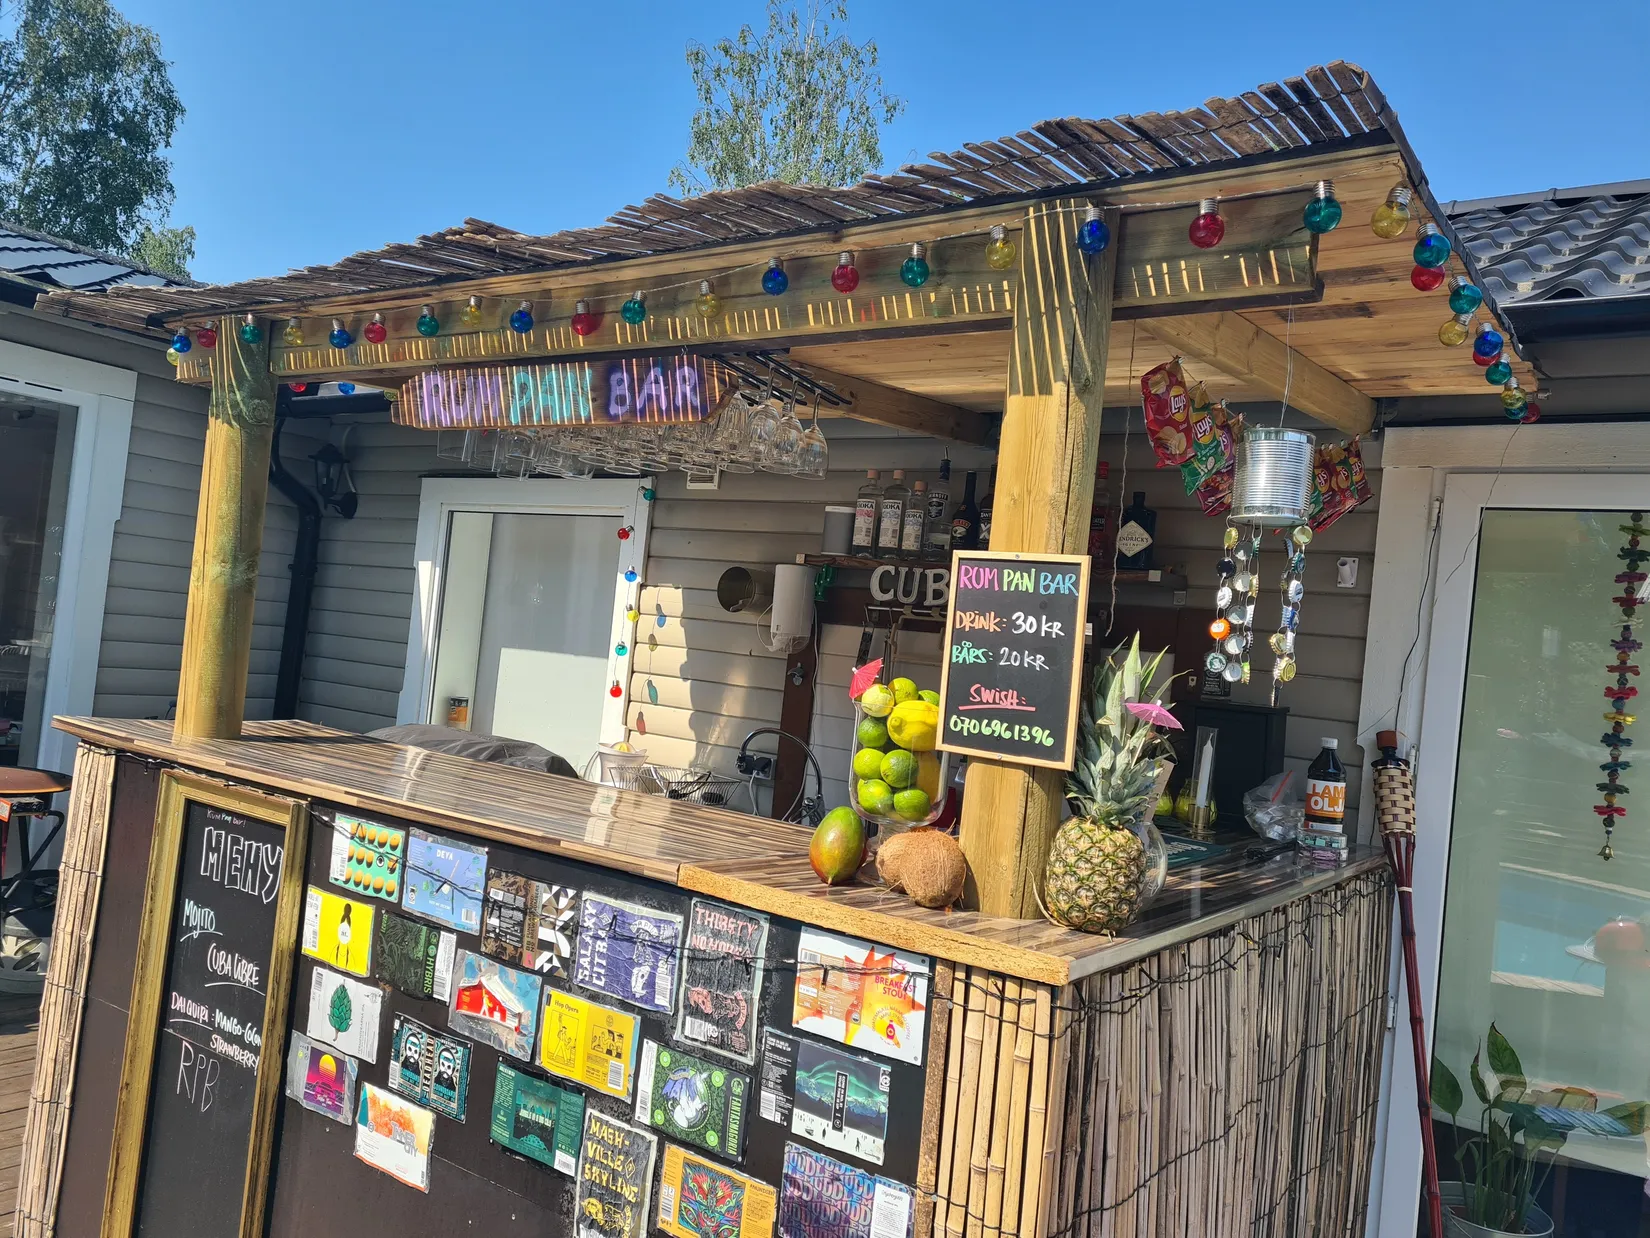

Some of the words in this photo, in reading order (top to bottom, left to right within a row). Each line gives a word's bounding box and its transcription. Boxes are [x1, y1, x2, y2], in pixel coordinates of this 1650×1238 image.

[421, 374, 502, 426] RUM
[510, 368, 592, 425] PAN
[608, 365, 699, 417] BAR
[959, 564, 1000, 592] RUM
[1002, 568, 1036, 593] PAN
[1039, 572, 1080, 596] BAR
[1011, 611, 1038, 634] 30
[999, 647, 1021, 667] 20
[949, 714, 1055, 747] 0706961396
[1312, 783, 1346, 798] LAM
[200, 826, 284, 905] MENY
[694, 906, 759, 941] THIRSTY
[423, 957, 436, 995] HYBRIS
[554, 998, 566, 1010] Hop
[882, 986, 908, 1001] STOUT
[423, 1036, 435, 1092] DEADHEAD
[726, 1096, 743, 1156] FANTASMAGORIA
[586, 1140, 624, 1170] VILLE
[583, 1161, 638, 1203] SKYLINE
